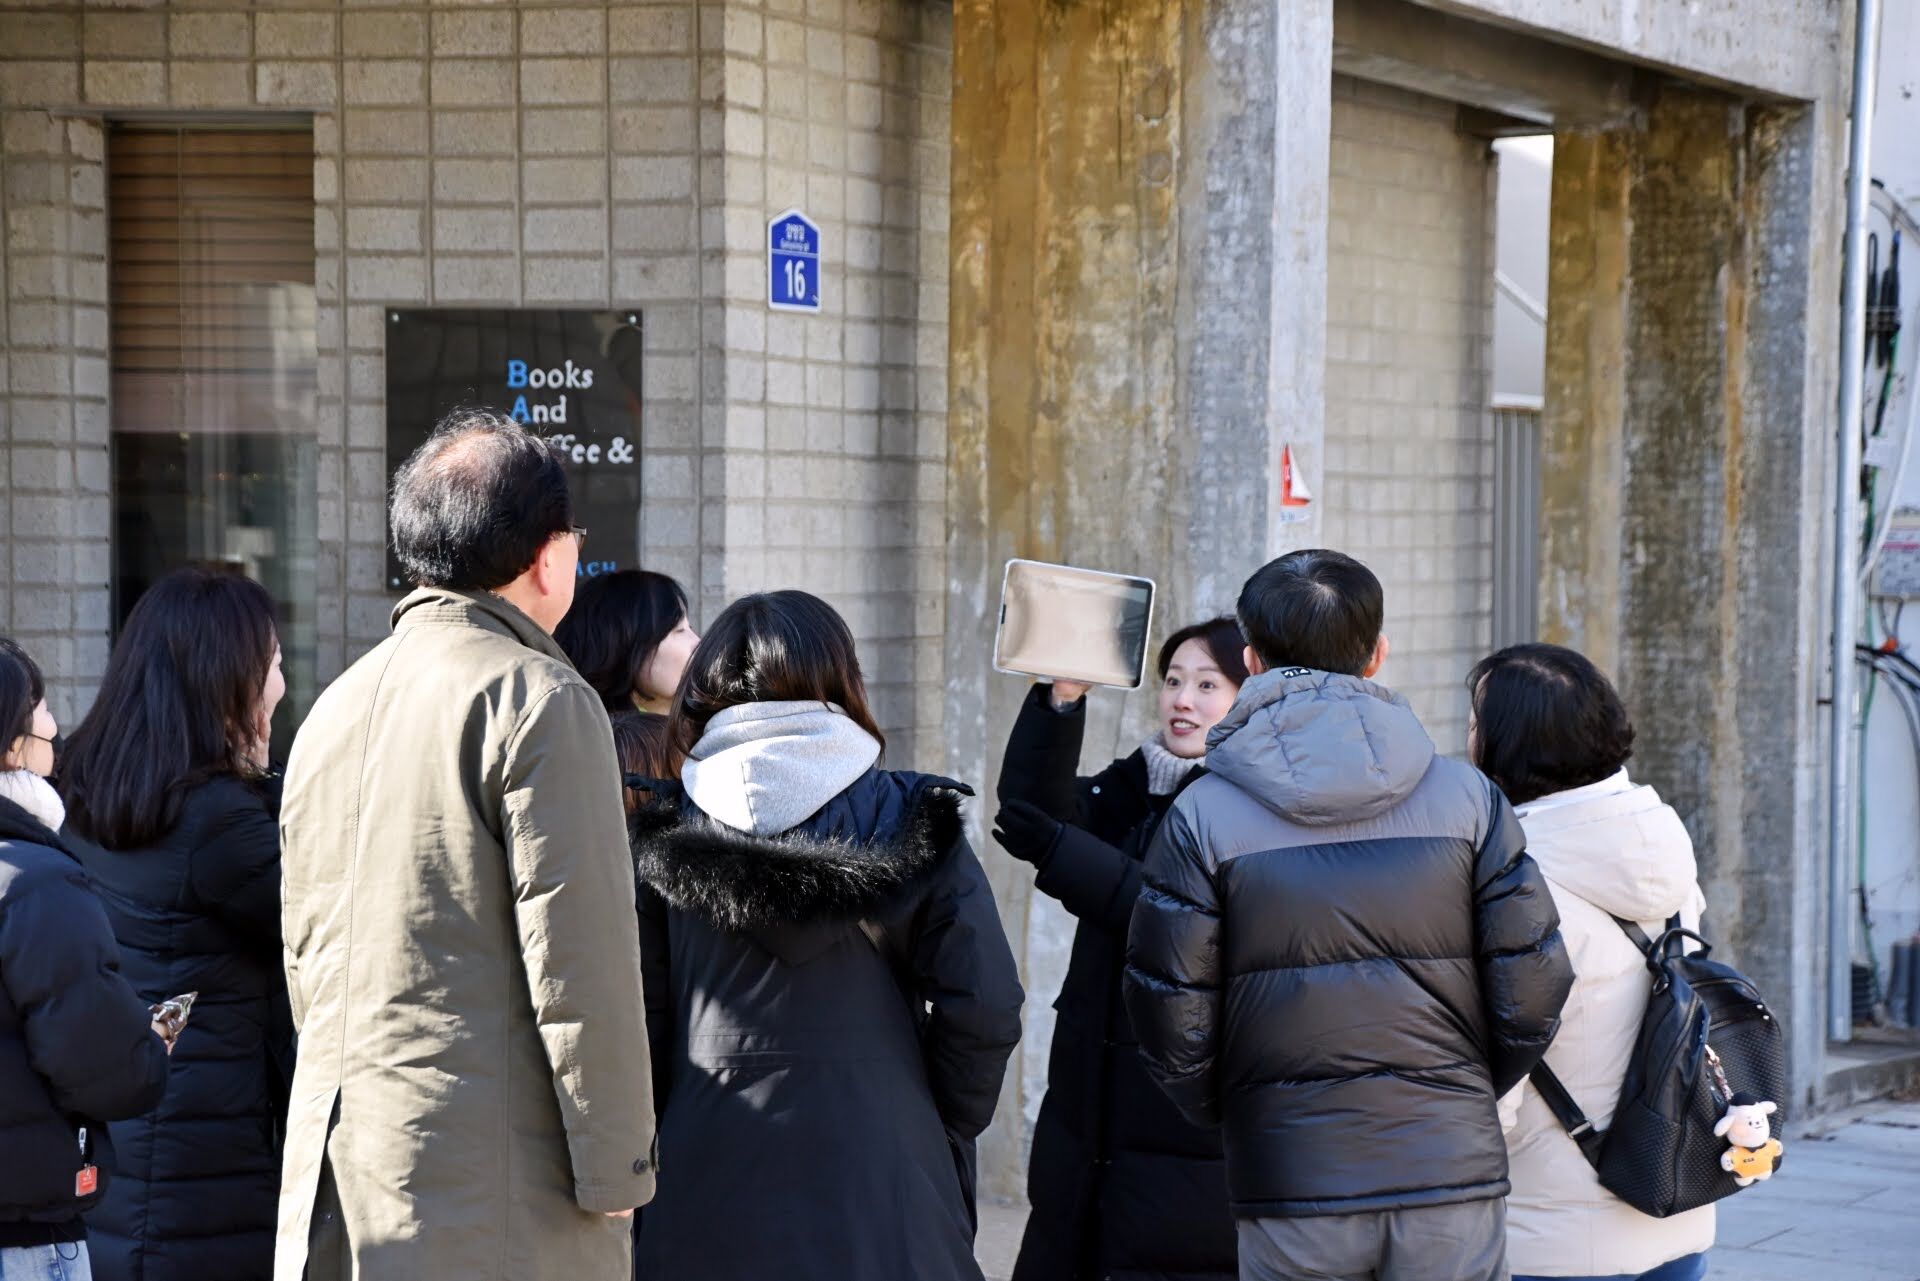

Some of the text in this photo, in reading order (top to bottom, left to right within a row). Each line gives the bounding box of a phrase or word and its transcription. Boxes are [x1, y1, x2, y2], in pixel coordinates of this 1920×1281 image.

[784, 259, 806, 300] 16
[507, 359, 594, 389] Books
[510, 395, 567, 425] And
[607, 437, 634, 464] &
